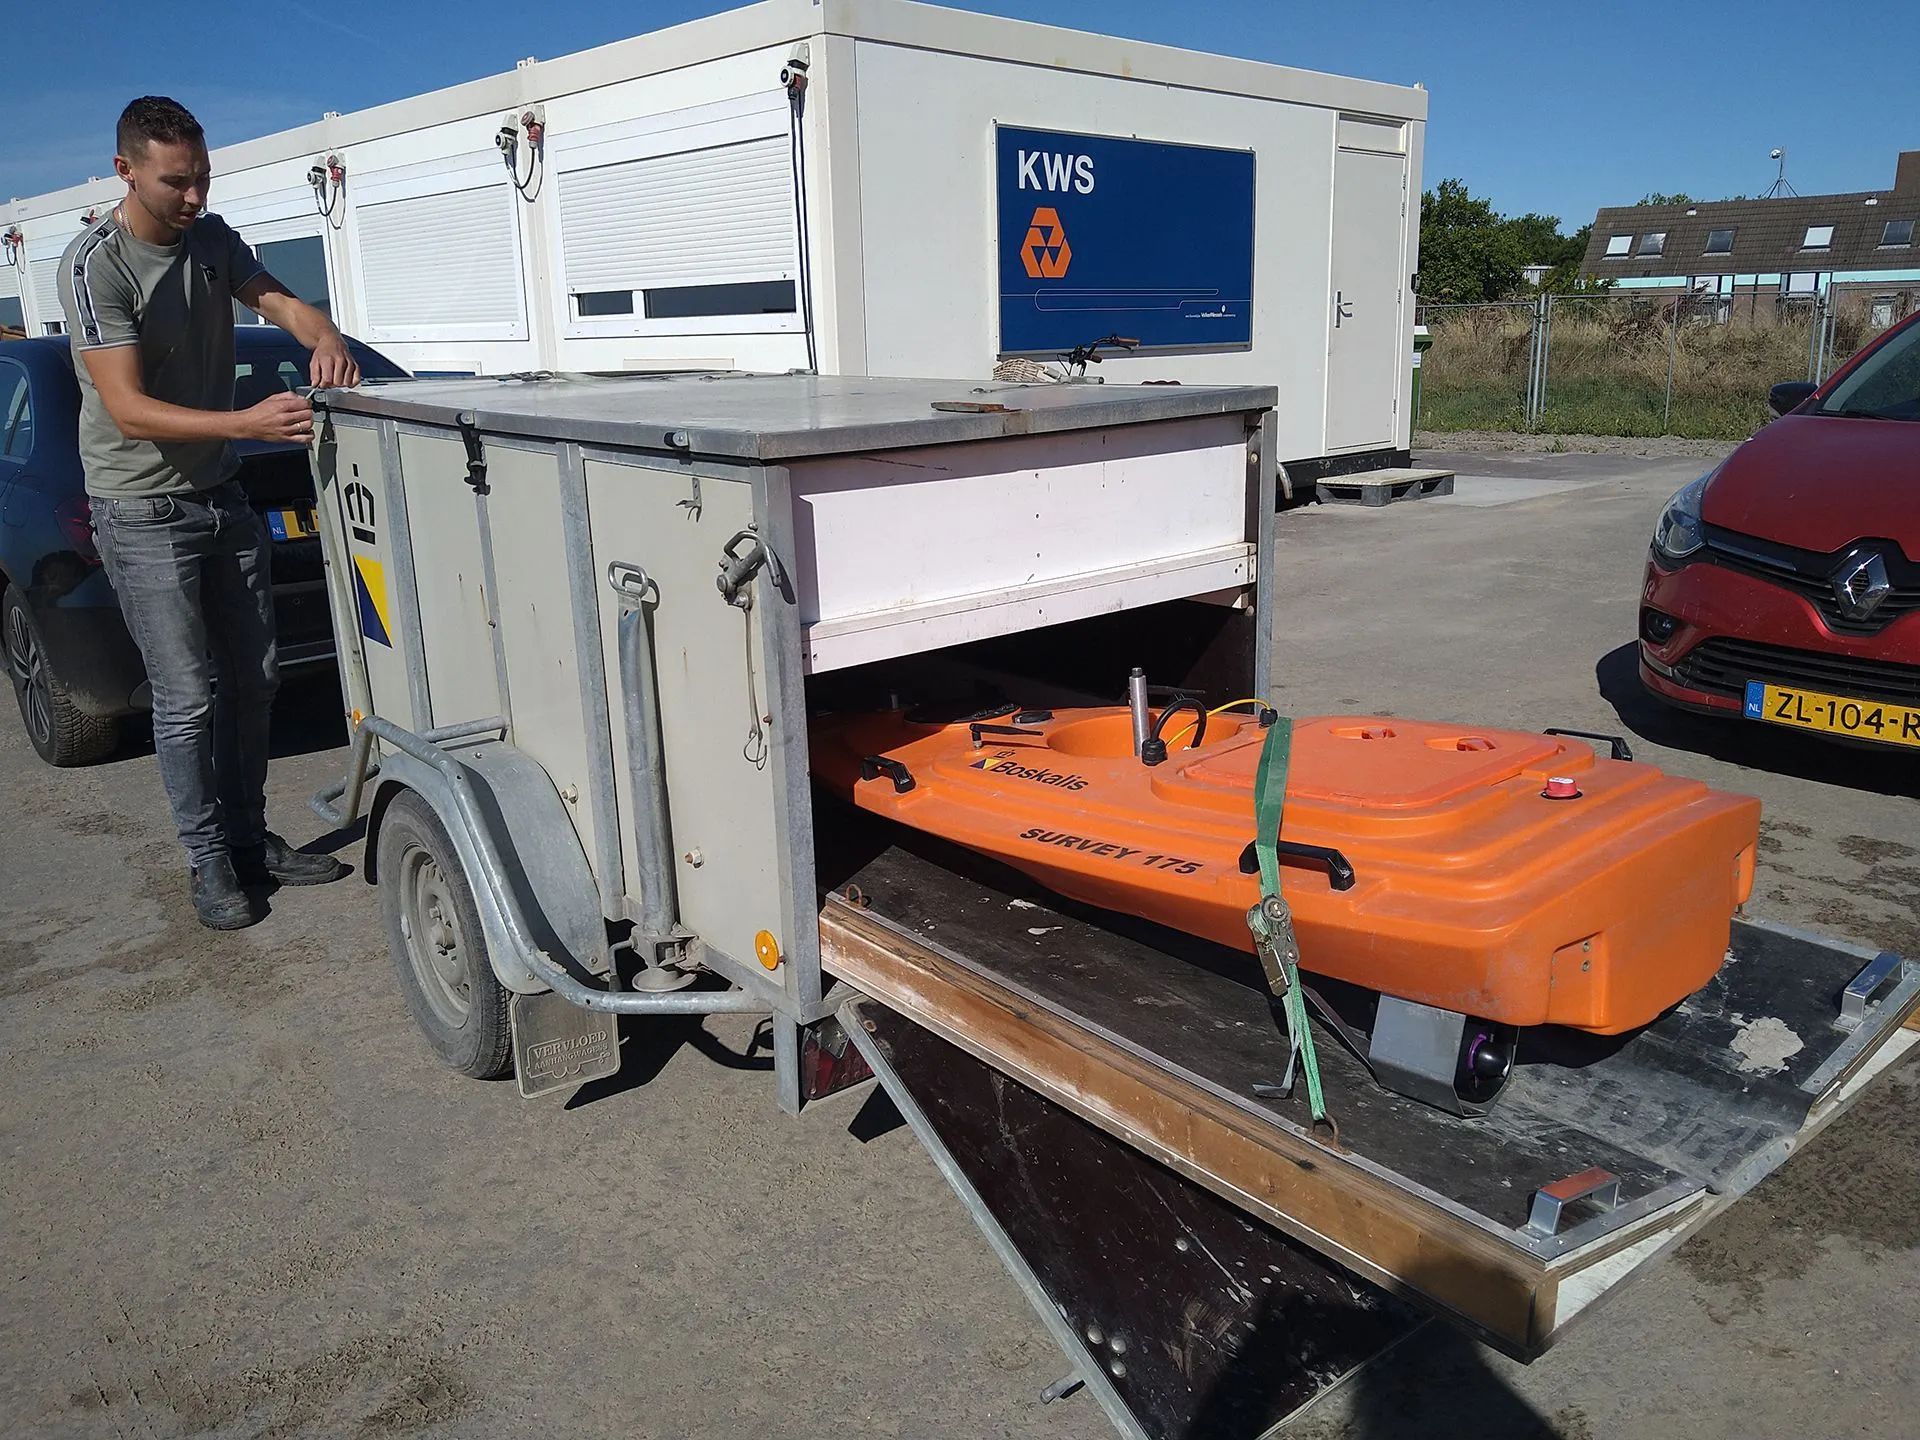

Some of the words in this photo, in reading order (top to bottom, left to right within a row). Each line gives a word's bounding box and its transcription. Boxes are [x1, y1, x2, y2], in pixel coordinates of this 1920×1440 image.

[1018, 150, 1095, 194] KWS
[272, 527, 285, 535] NL
[1748, 703, 1761, 713] NL
[992, 761, 1089, 791] Boskalis
[1020, 828, 1141, 859] SURVEY
[1143, 854, 1204, 874] 175
